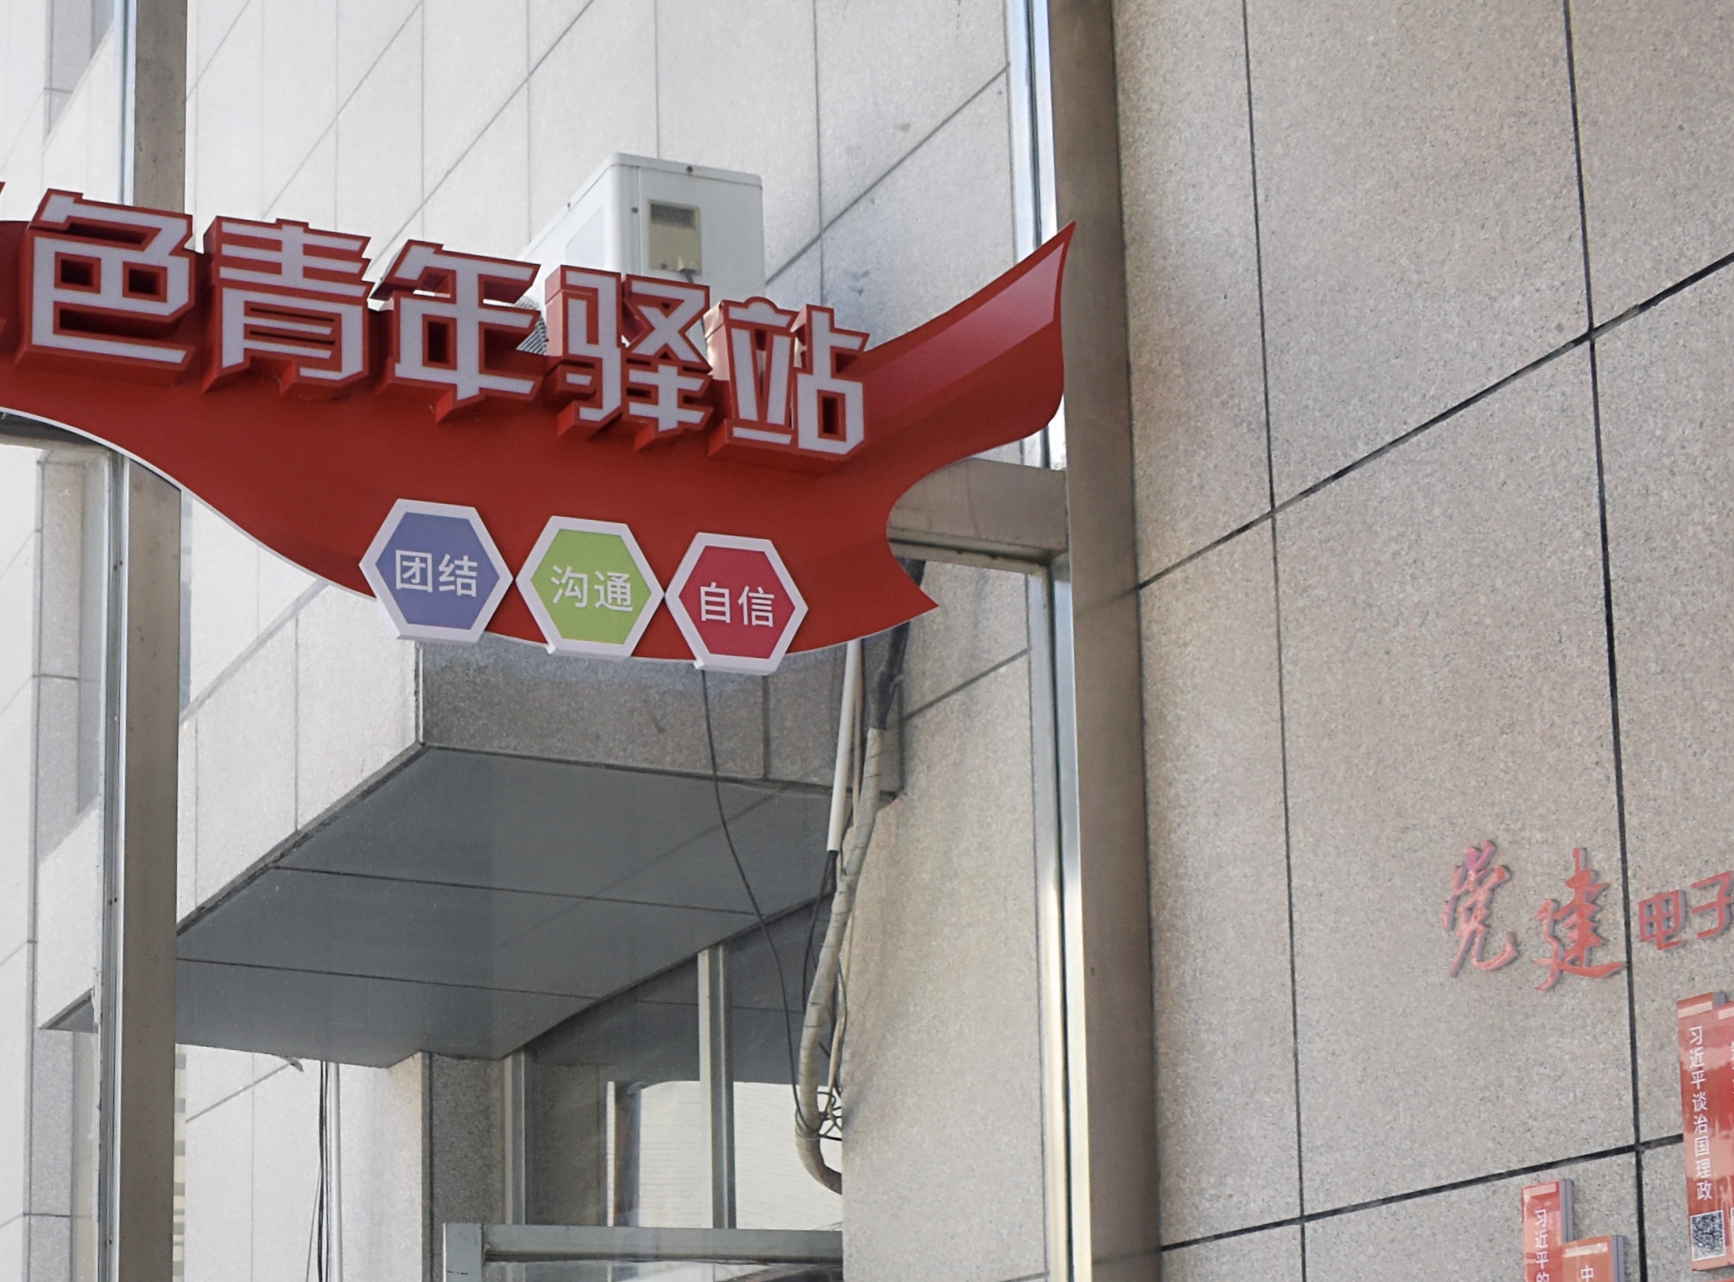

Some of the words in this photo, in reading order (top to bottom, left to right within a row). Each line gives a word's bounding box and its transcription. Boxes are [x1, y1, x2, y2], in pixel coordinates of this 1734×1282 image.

[394, 548, 479, 598] 团结
[550, 564, 634, 613] 沟通
[699, 582, 775, 628] 自信
[1688, 1025, 1713, 1201] 习近平谈治国理政
